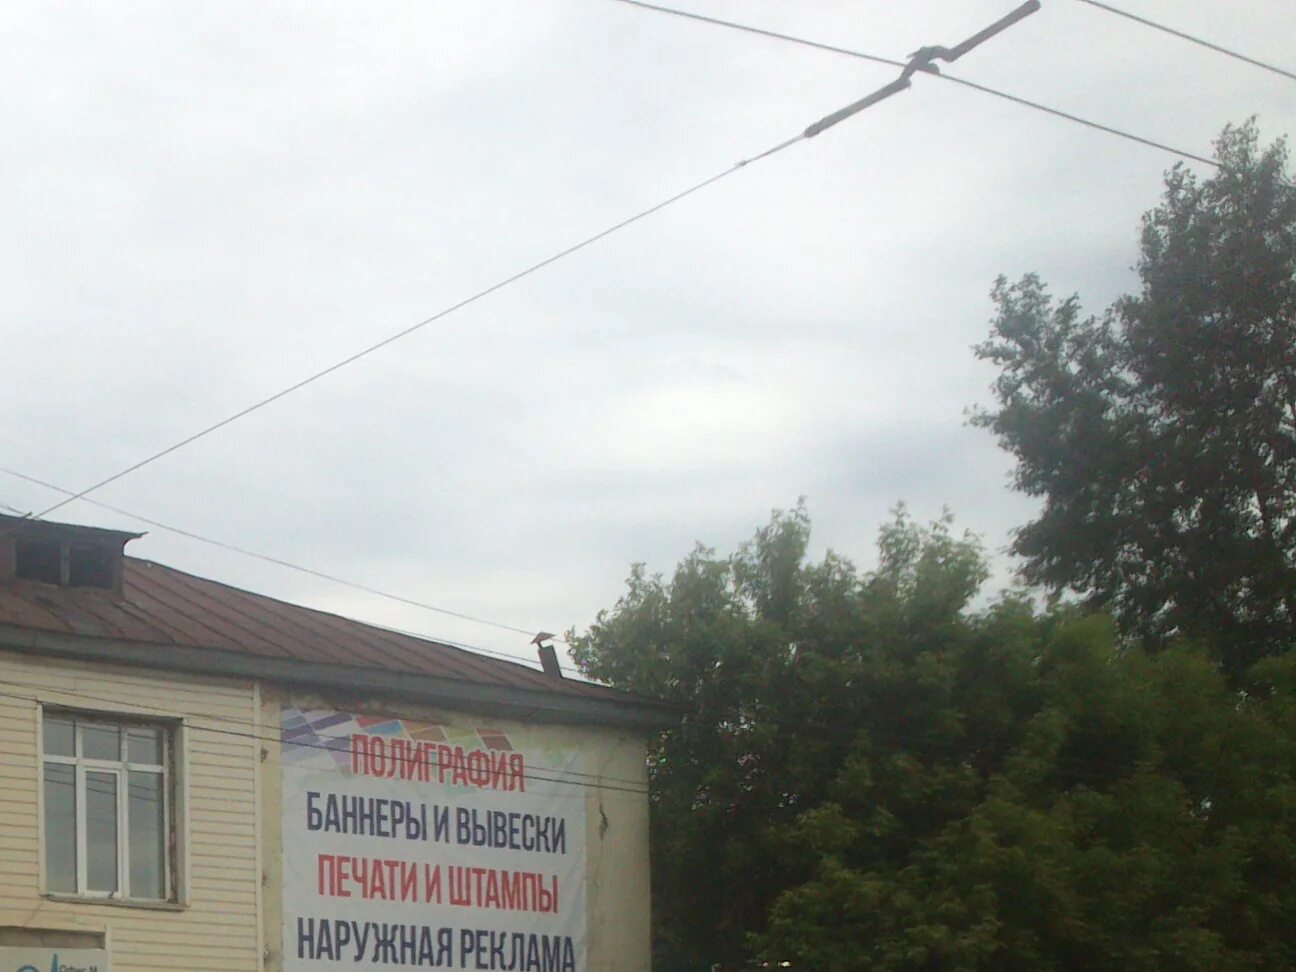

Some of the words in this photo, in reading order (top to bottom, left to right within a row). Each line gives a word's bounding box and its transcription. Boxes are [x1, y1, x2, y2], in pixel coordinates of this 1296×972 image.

[352, 734, 525, 793] ПОЛИГРАФИЯ
[306, 791, 427, 842] БАННЕРЫ
[433, 804, 450, 845] И
[455, 807, 566, 855] ВЫВЕСКИ
[318, 853, 417, 902] ПЕЧАТИ
[424, 863, 442, 904] И
[448, 865, 559, 914] ШТАМПЫ
[297, 917, 453, 968] НАРУЖНАЯ
